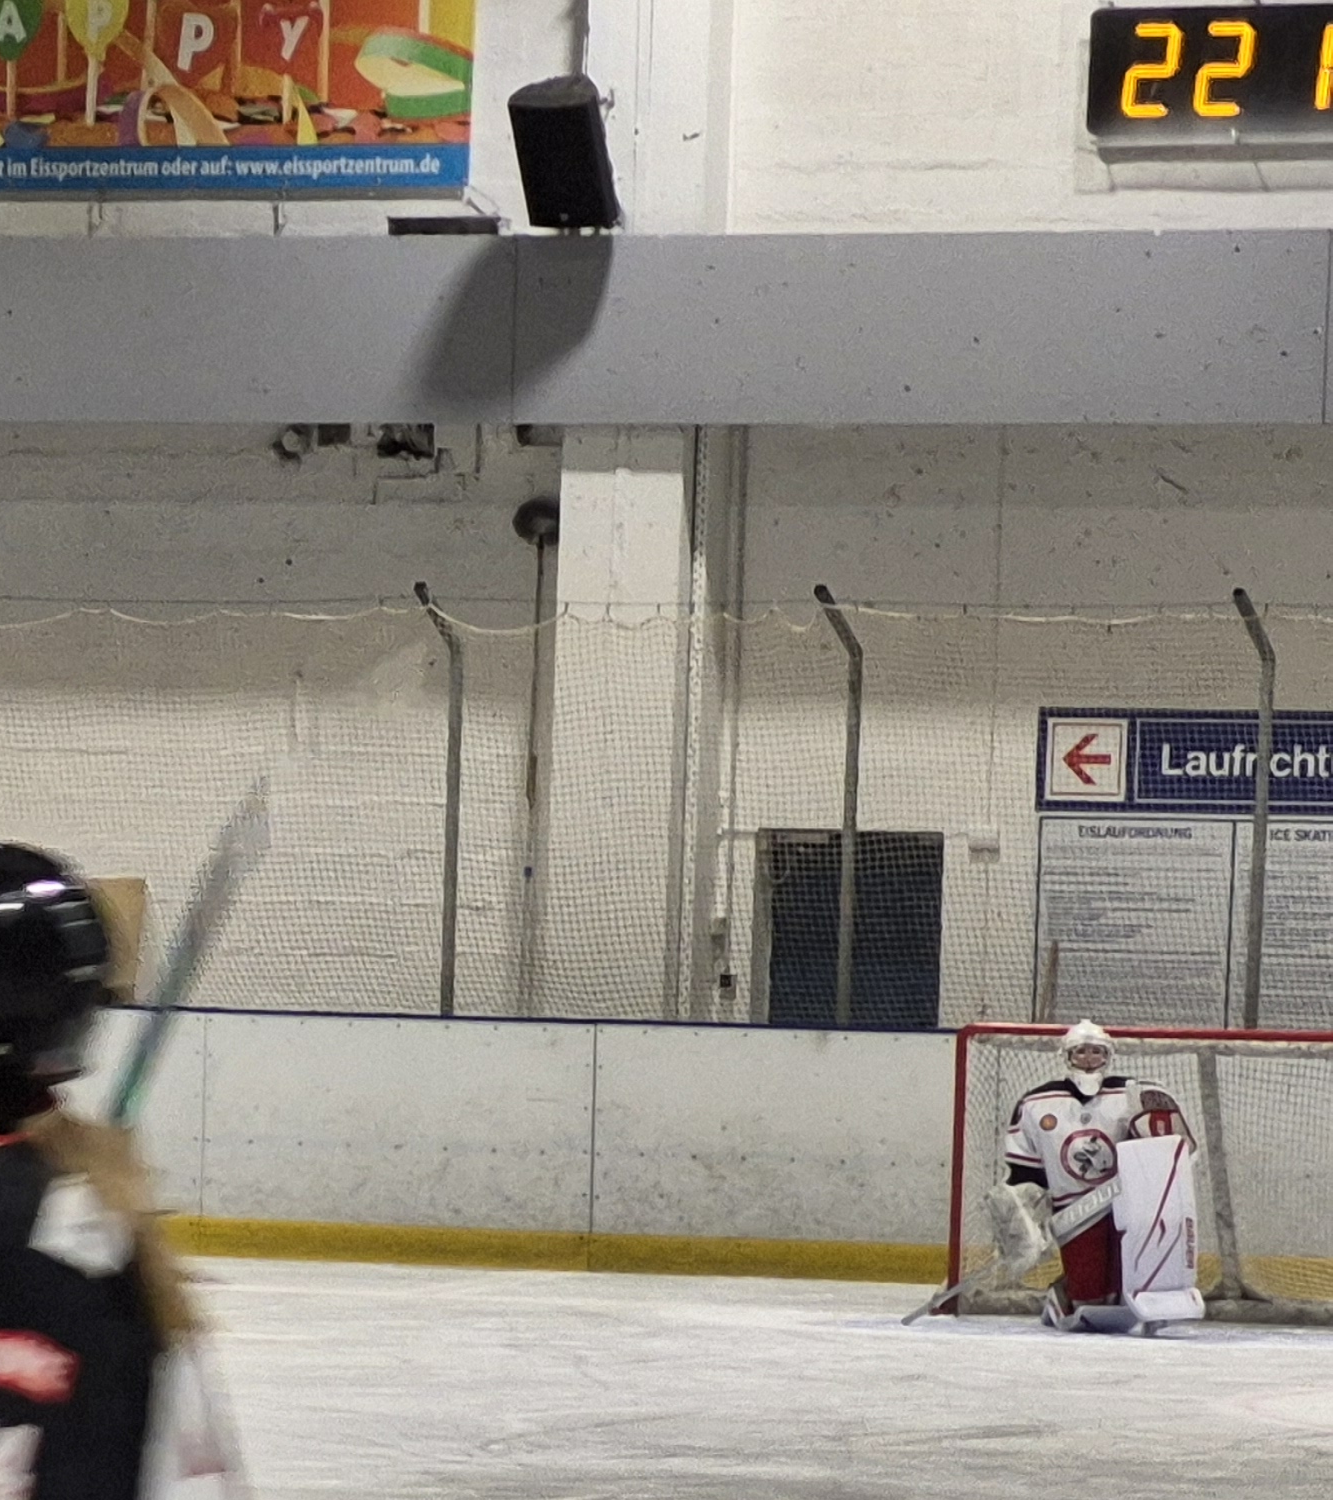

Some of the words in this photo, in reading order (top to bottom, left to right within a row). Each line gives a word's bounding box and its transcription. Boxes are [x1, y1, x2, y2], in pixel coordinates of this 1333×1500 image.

[1121, 21, 1258, 117] 22
[7, 158, 26, 177] im
[30, 157, 158, 182] Eissportzentrum
[161, 156, 197, 175] oder
[200, 156, 232, 175] auf:
[236, 154, 440, 180] www.eissportzentrum.de
[1161, 743, 1333, 778] Laufrcht
